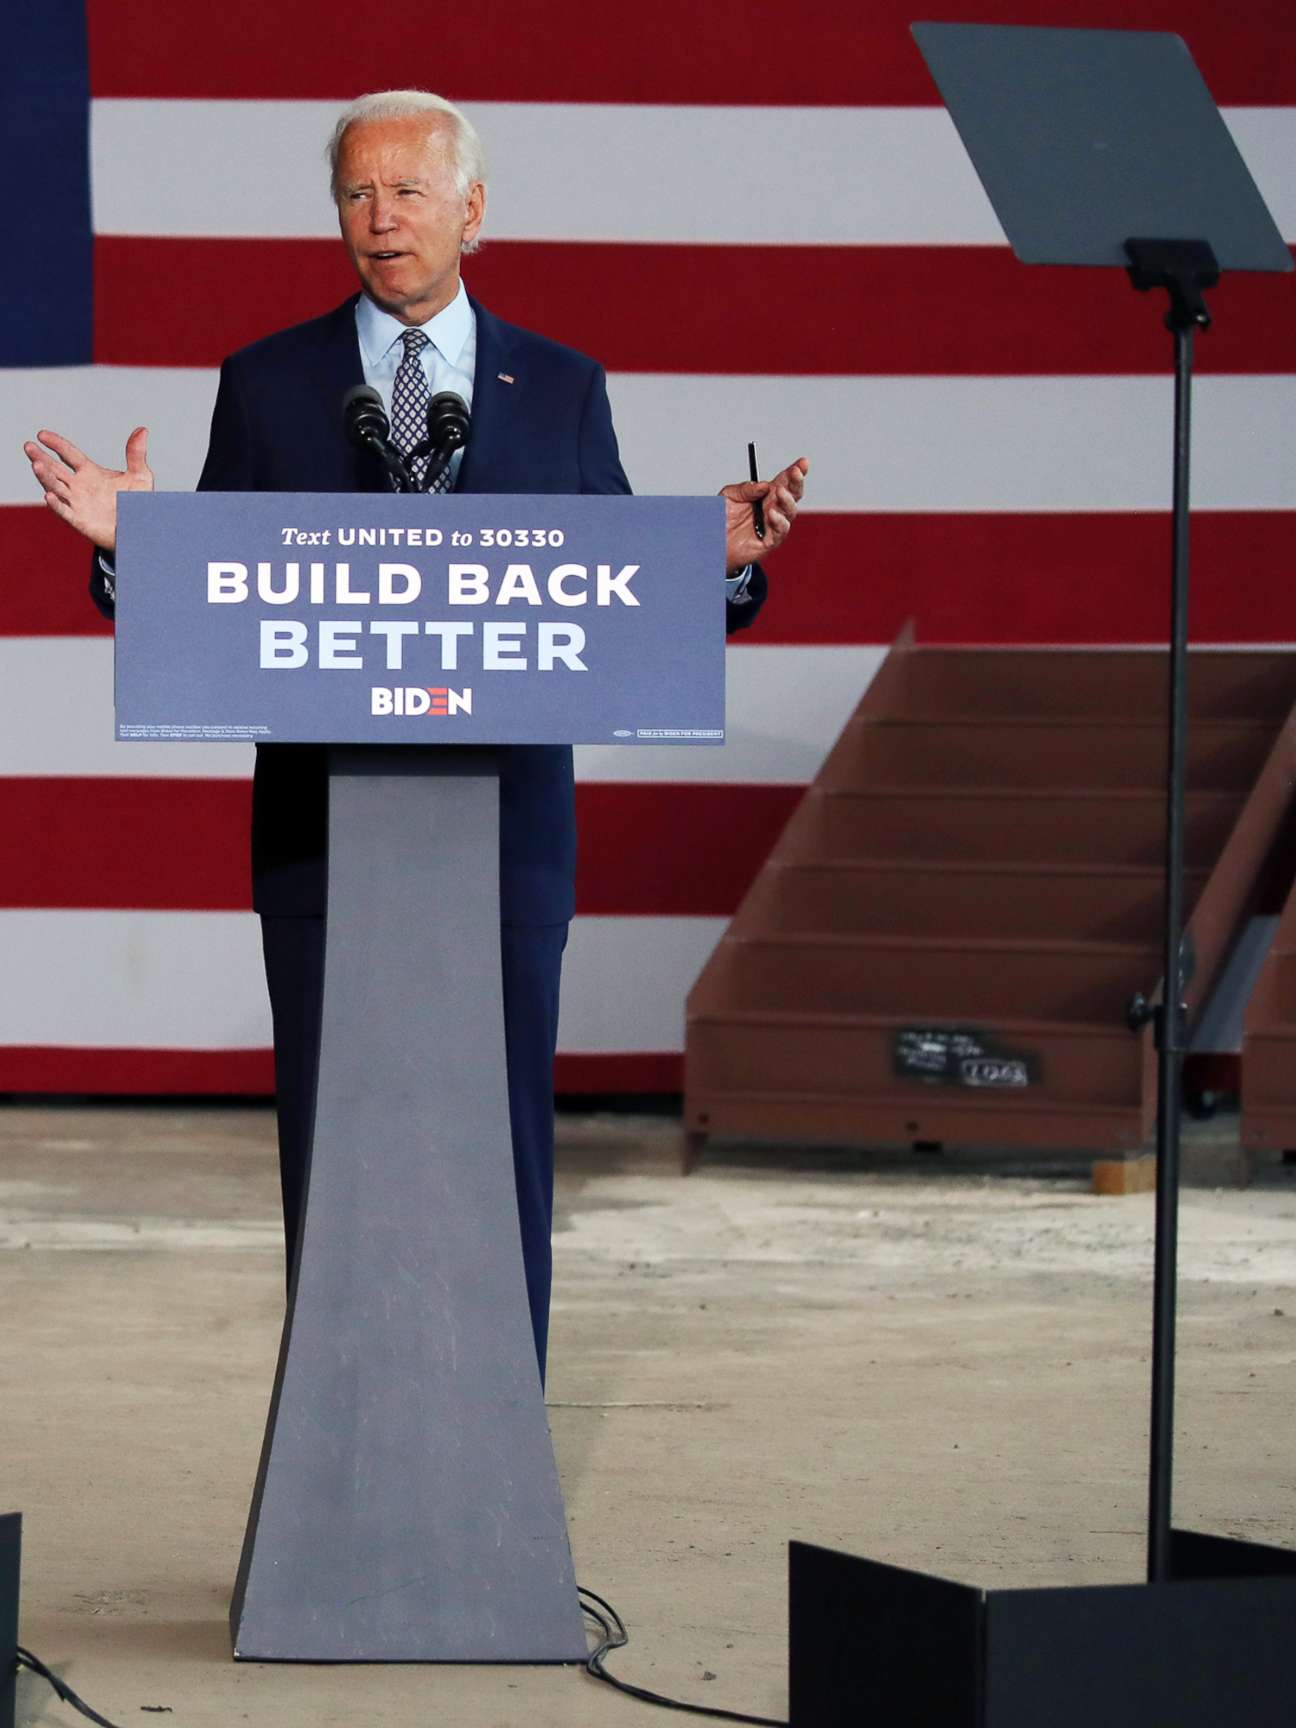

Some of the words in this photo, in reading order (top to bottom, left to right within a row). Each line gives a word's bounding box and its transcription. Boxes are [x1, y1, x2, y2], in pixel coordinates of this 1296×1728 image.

[281, 527, 332, 546] Text
[338, 528, 443, 547] UNITED
[451, 530, 473, 547] to
[480, 529, 565, 548] 30330
[207, 562, 422, 604] BUILD
[448, 564, 641, 606] BACK
[259, 620, 589, 671] BETTER
[371, 687, 472, 716] BIDEN
